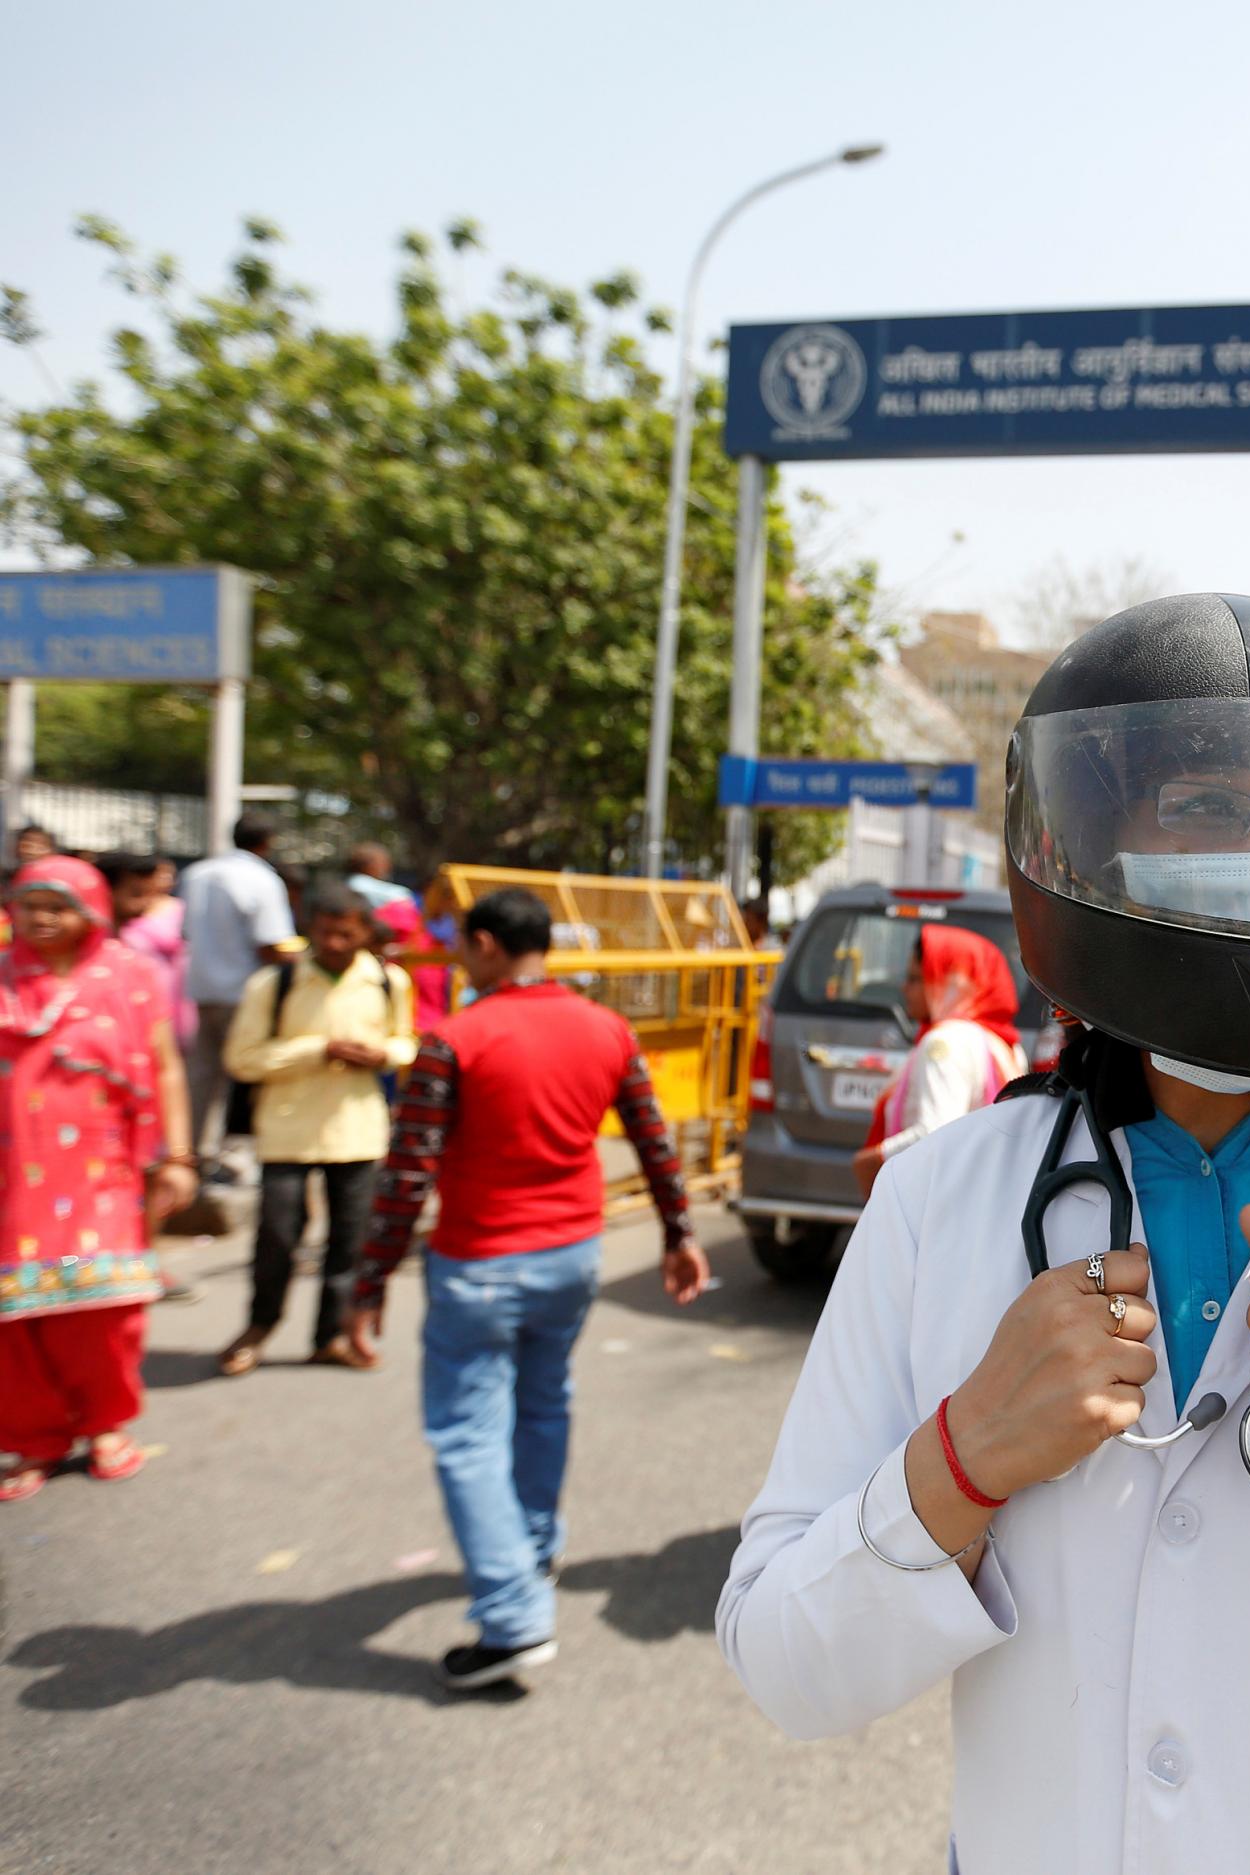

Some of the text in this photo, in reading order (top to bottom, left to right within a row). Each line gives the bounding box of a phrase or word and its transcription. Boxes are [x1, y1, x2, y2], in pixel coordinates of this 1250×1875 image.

[879, 345, 961, 385] अखिल
[970, 340, 1061, 382] भारतीय
[876, 391, 917, 418] ALL
[919, 388, 981, 416] INDIA
[984, 384, 1098, 414] INSTITUTE
[1099, 383, 1129, 411] OF
[1133, 381, 1233, 410] MEDICAL
